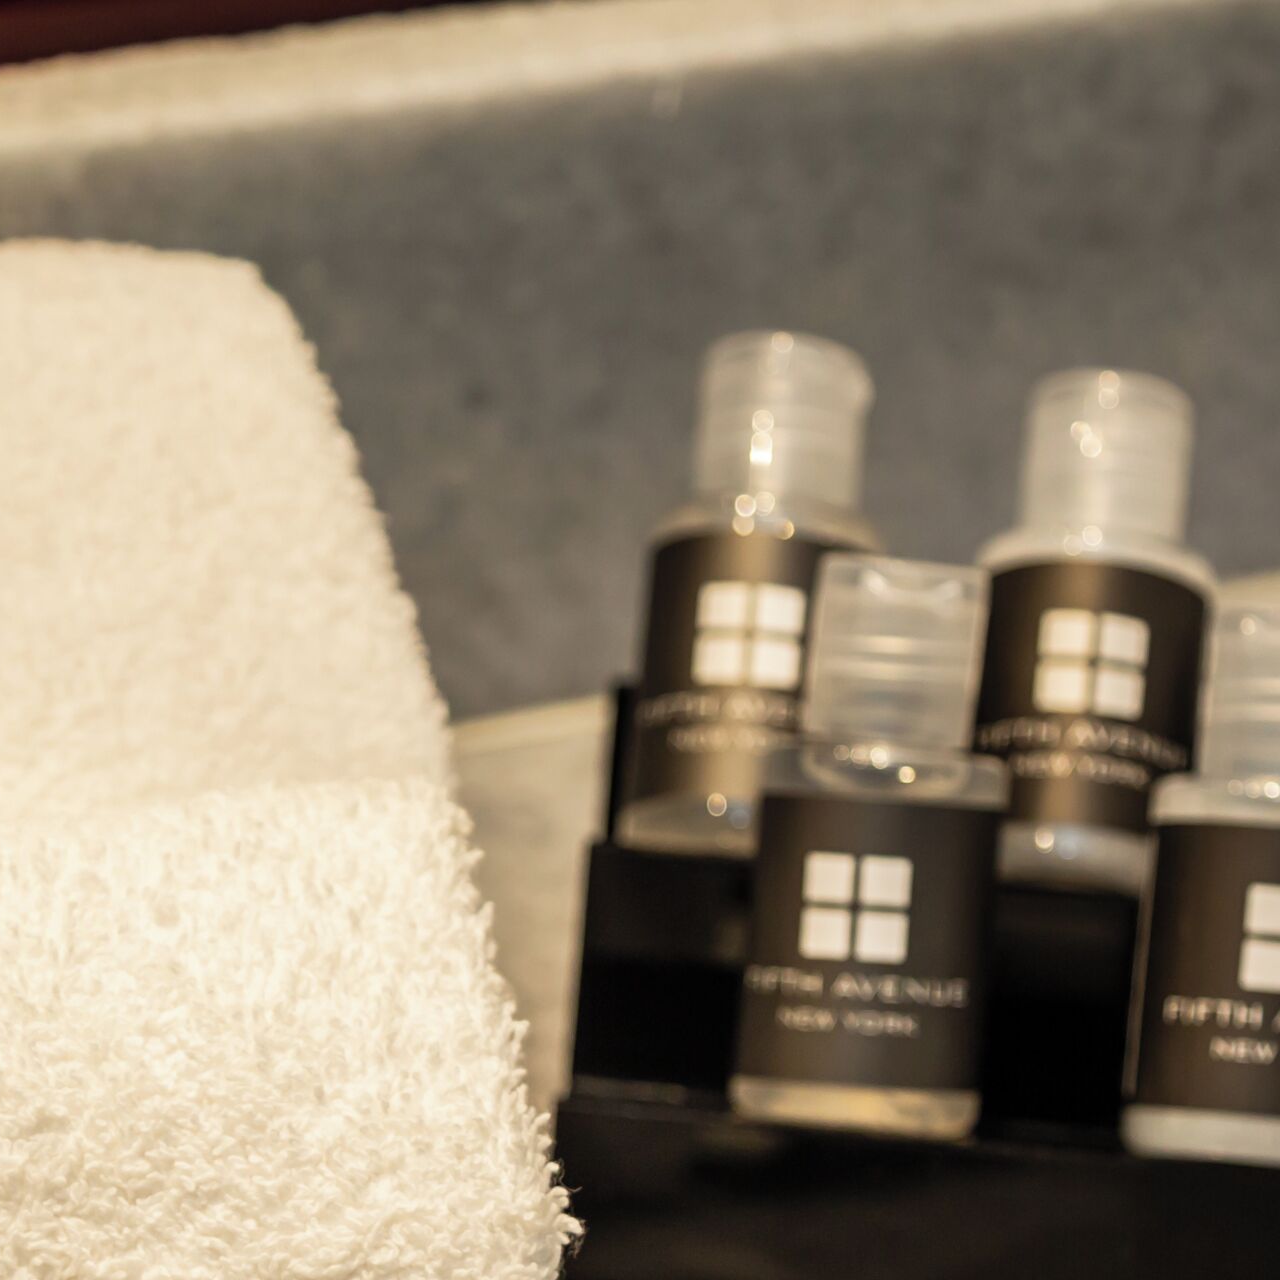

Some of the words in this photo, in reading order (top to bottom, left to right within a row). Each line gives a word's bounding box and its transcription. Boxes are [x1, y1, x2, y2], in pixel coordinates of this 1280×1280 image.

[831, 972, 968, 1008] AVENUE
[1163, 994, 1264, 1031] FIFTH
[1209, 1036, 1278, 1065] NEW
